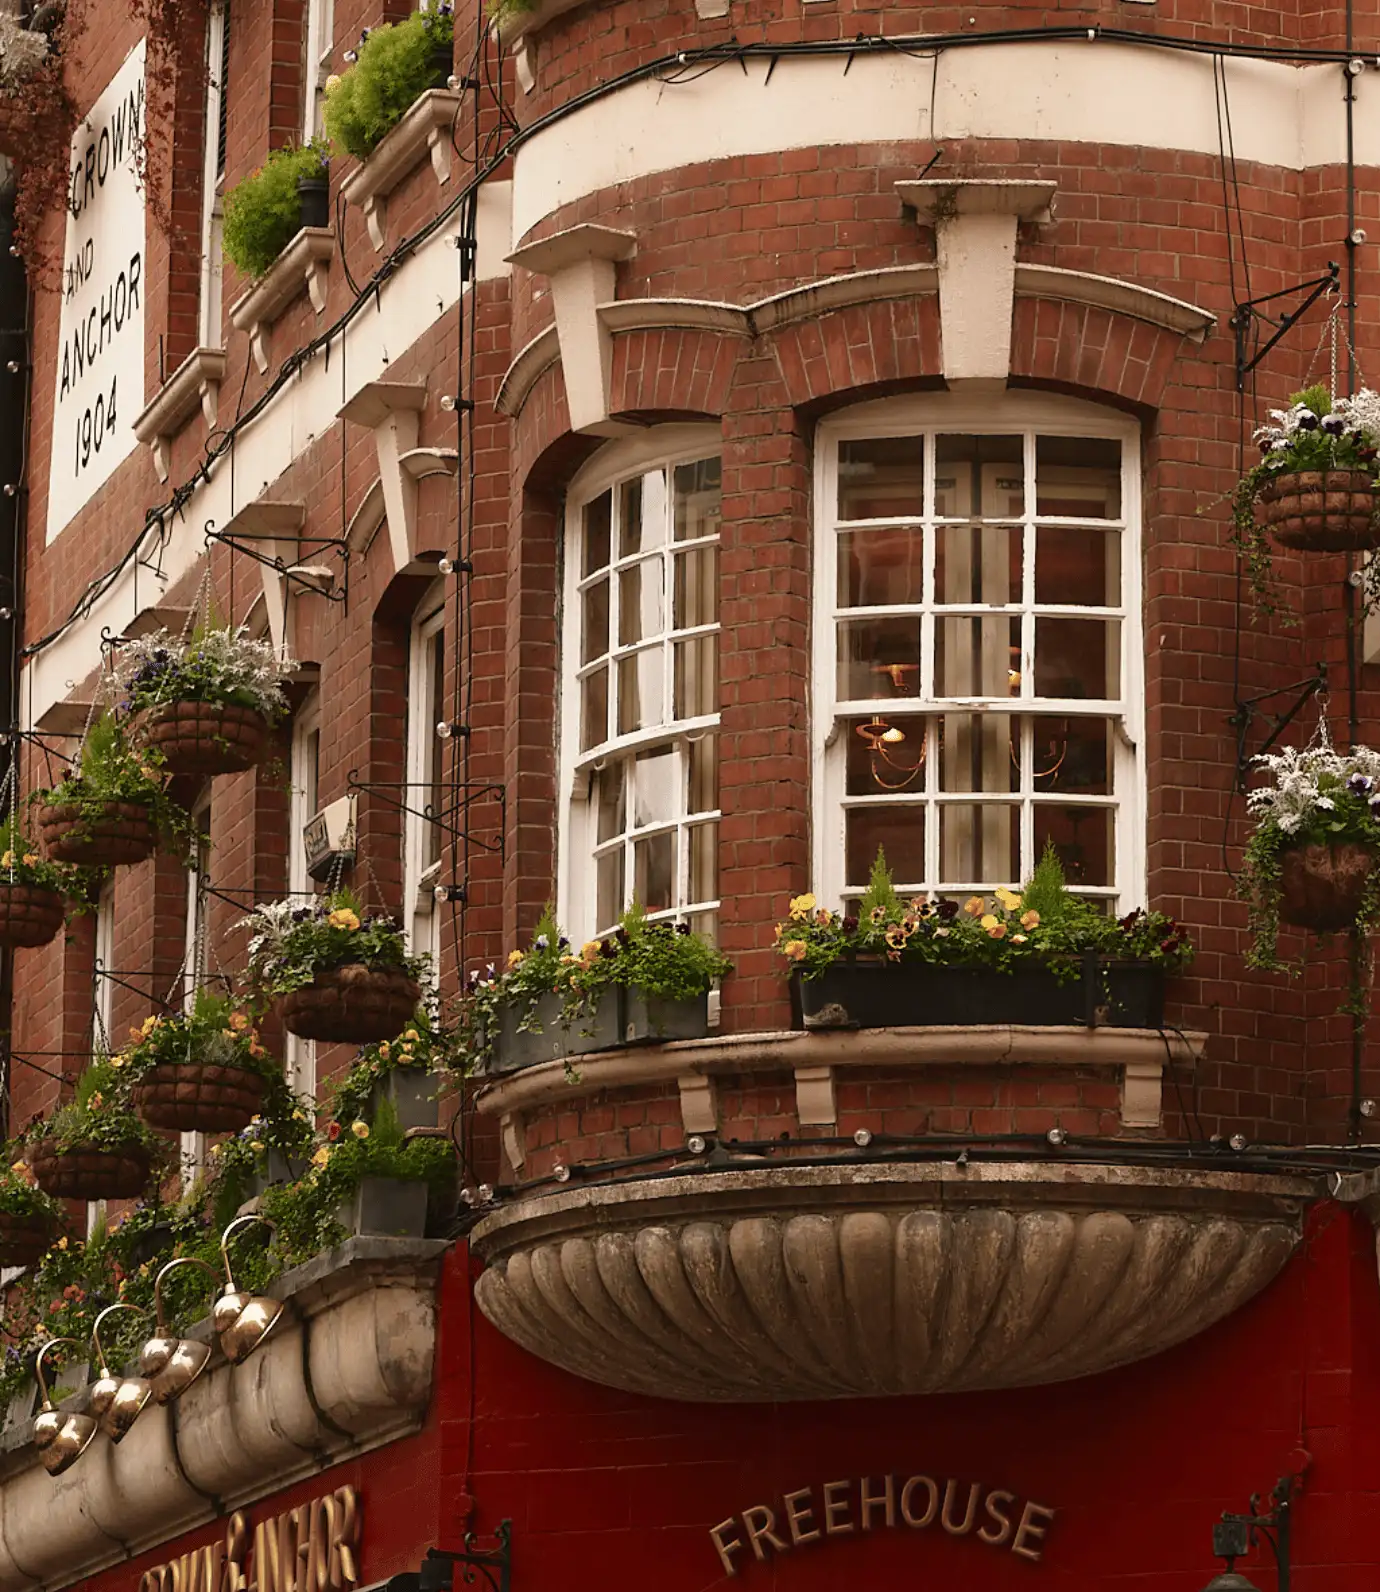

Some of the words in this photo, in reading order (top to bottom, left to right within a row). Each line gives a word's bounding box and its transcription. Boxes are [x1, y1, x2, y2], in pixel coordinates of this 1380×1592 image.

[70, 78, 145, 221] CROWN
[65, 237, 94, 306] AND
[59, 251, 141, 403] ANCHOR
[74, 375, 118, 477] 1904
[709, 1474, 1055, 1577] FREEHOUSE
